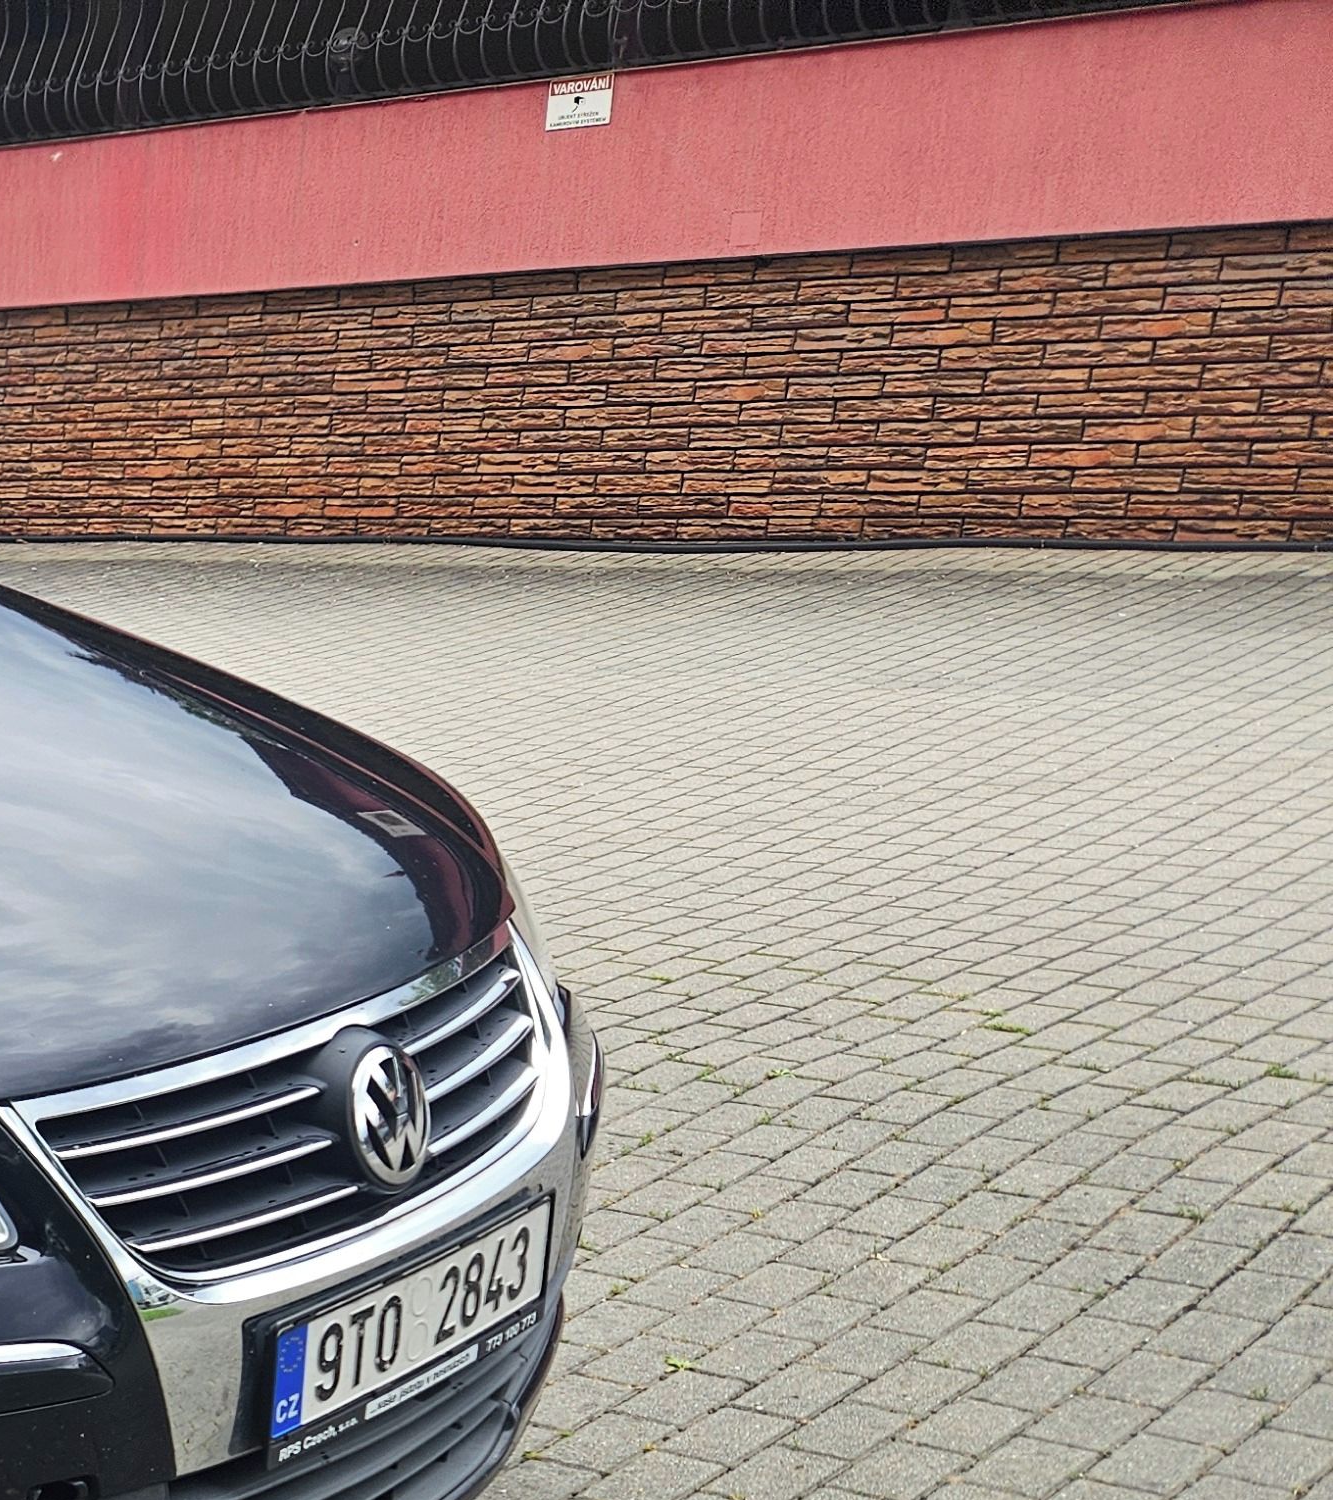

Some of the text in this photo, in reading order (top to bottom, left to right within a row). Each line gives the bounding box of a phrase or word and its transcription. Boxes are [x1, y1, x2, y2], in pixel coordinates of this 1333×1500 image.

[553, 76, 609, 94] VAROVÁNÍ
[435, 1226, 530, 1345] 2843
[275, 1392, 300, 1424] CZ
